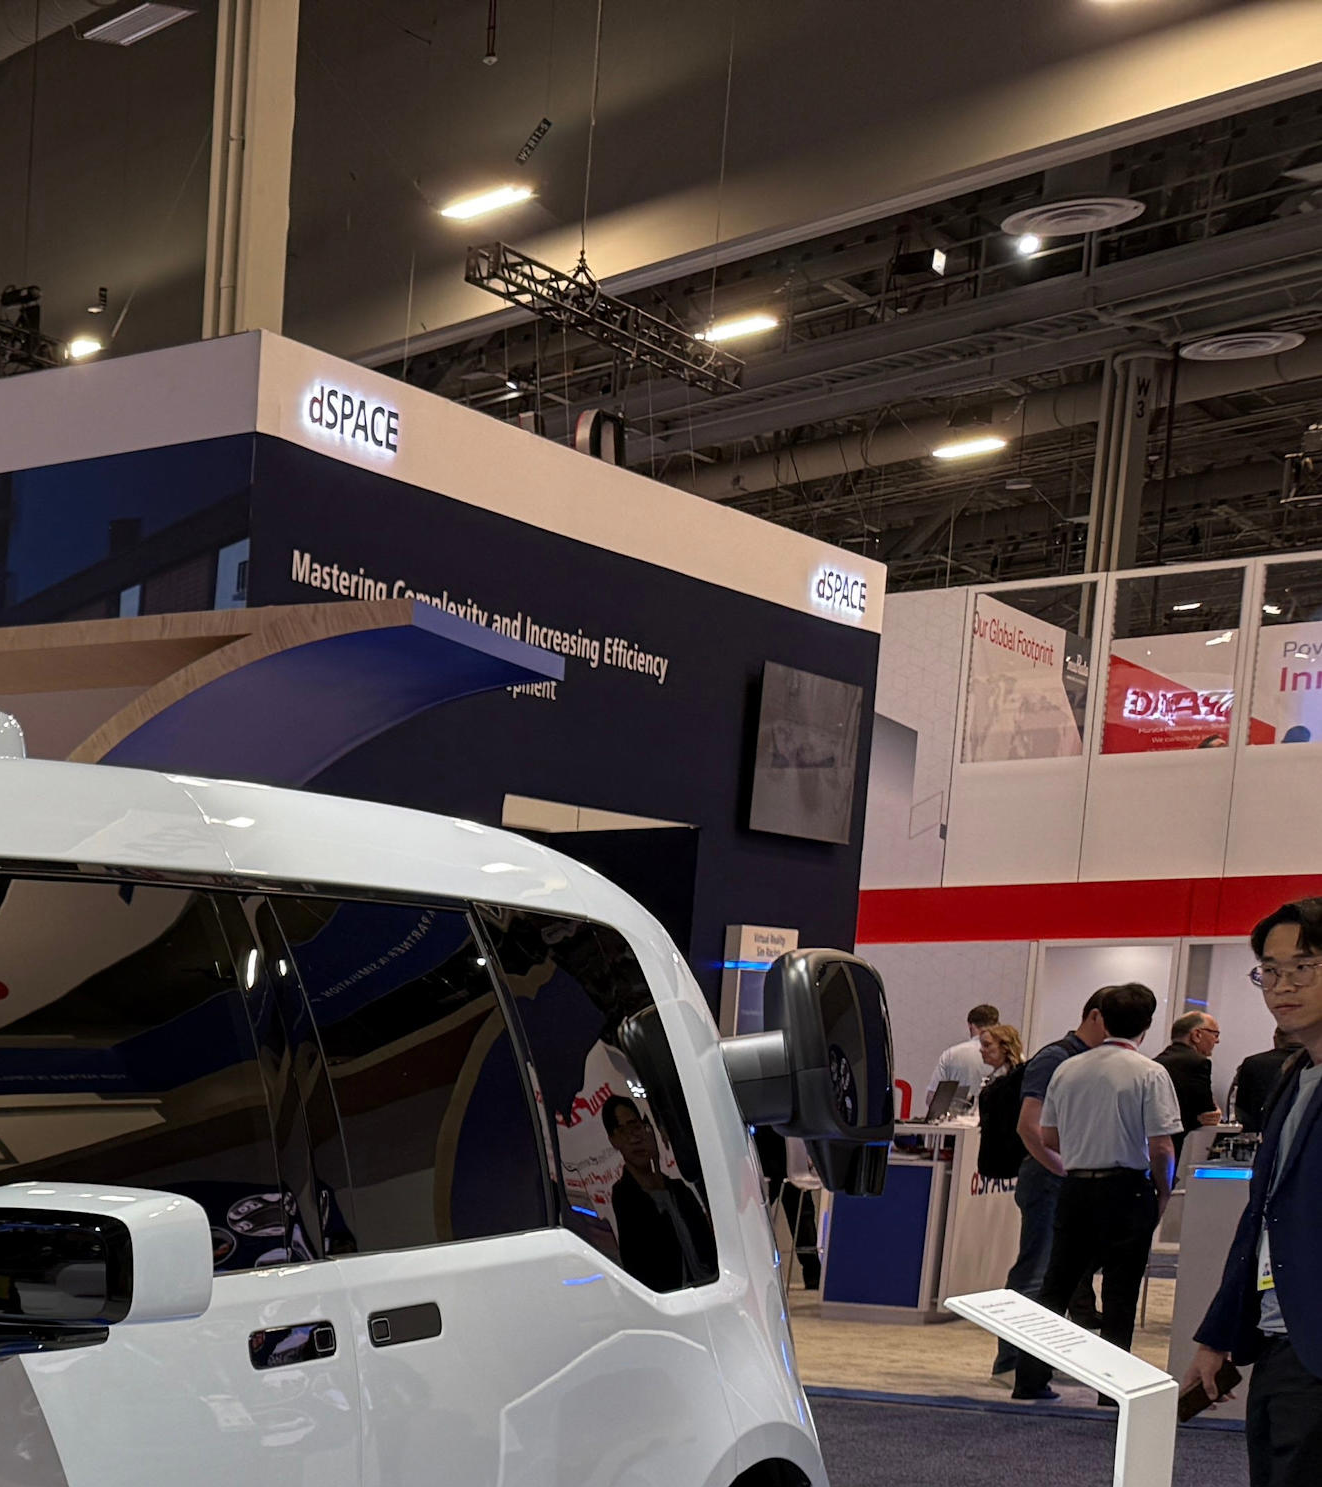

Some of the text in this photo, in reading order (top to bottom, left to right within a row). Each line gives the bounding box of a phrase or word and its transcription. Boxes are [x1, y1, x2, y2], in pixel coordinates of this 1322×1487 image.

[309, 385, 399, 454] dSPACE
[292, 549, 387, 601] Mastering
[492, 612, 522, 641] and
[525, 615, 601, 669] Increasing
[603, 637, 669, 685] Efficiency
[817, 569, 867, 613] dSPACE
[989, 618, 1017, 652] Global
